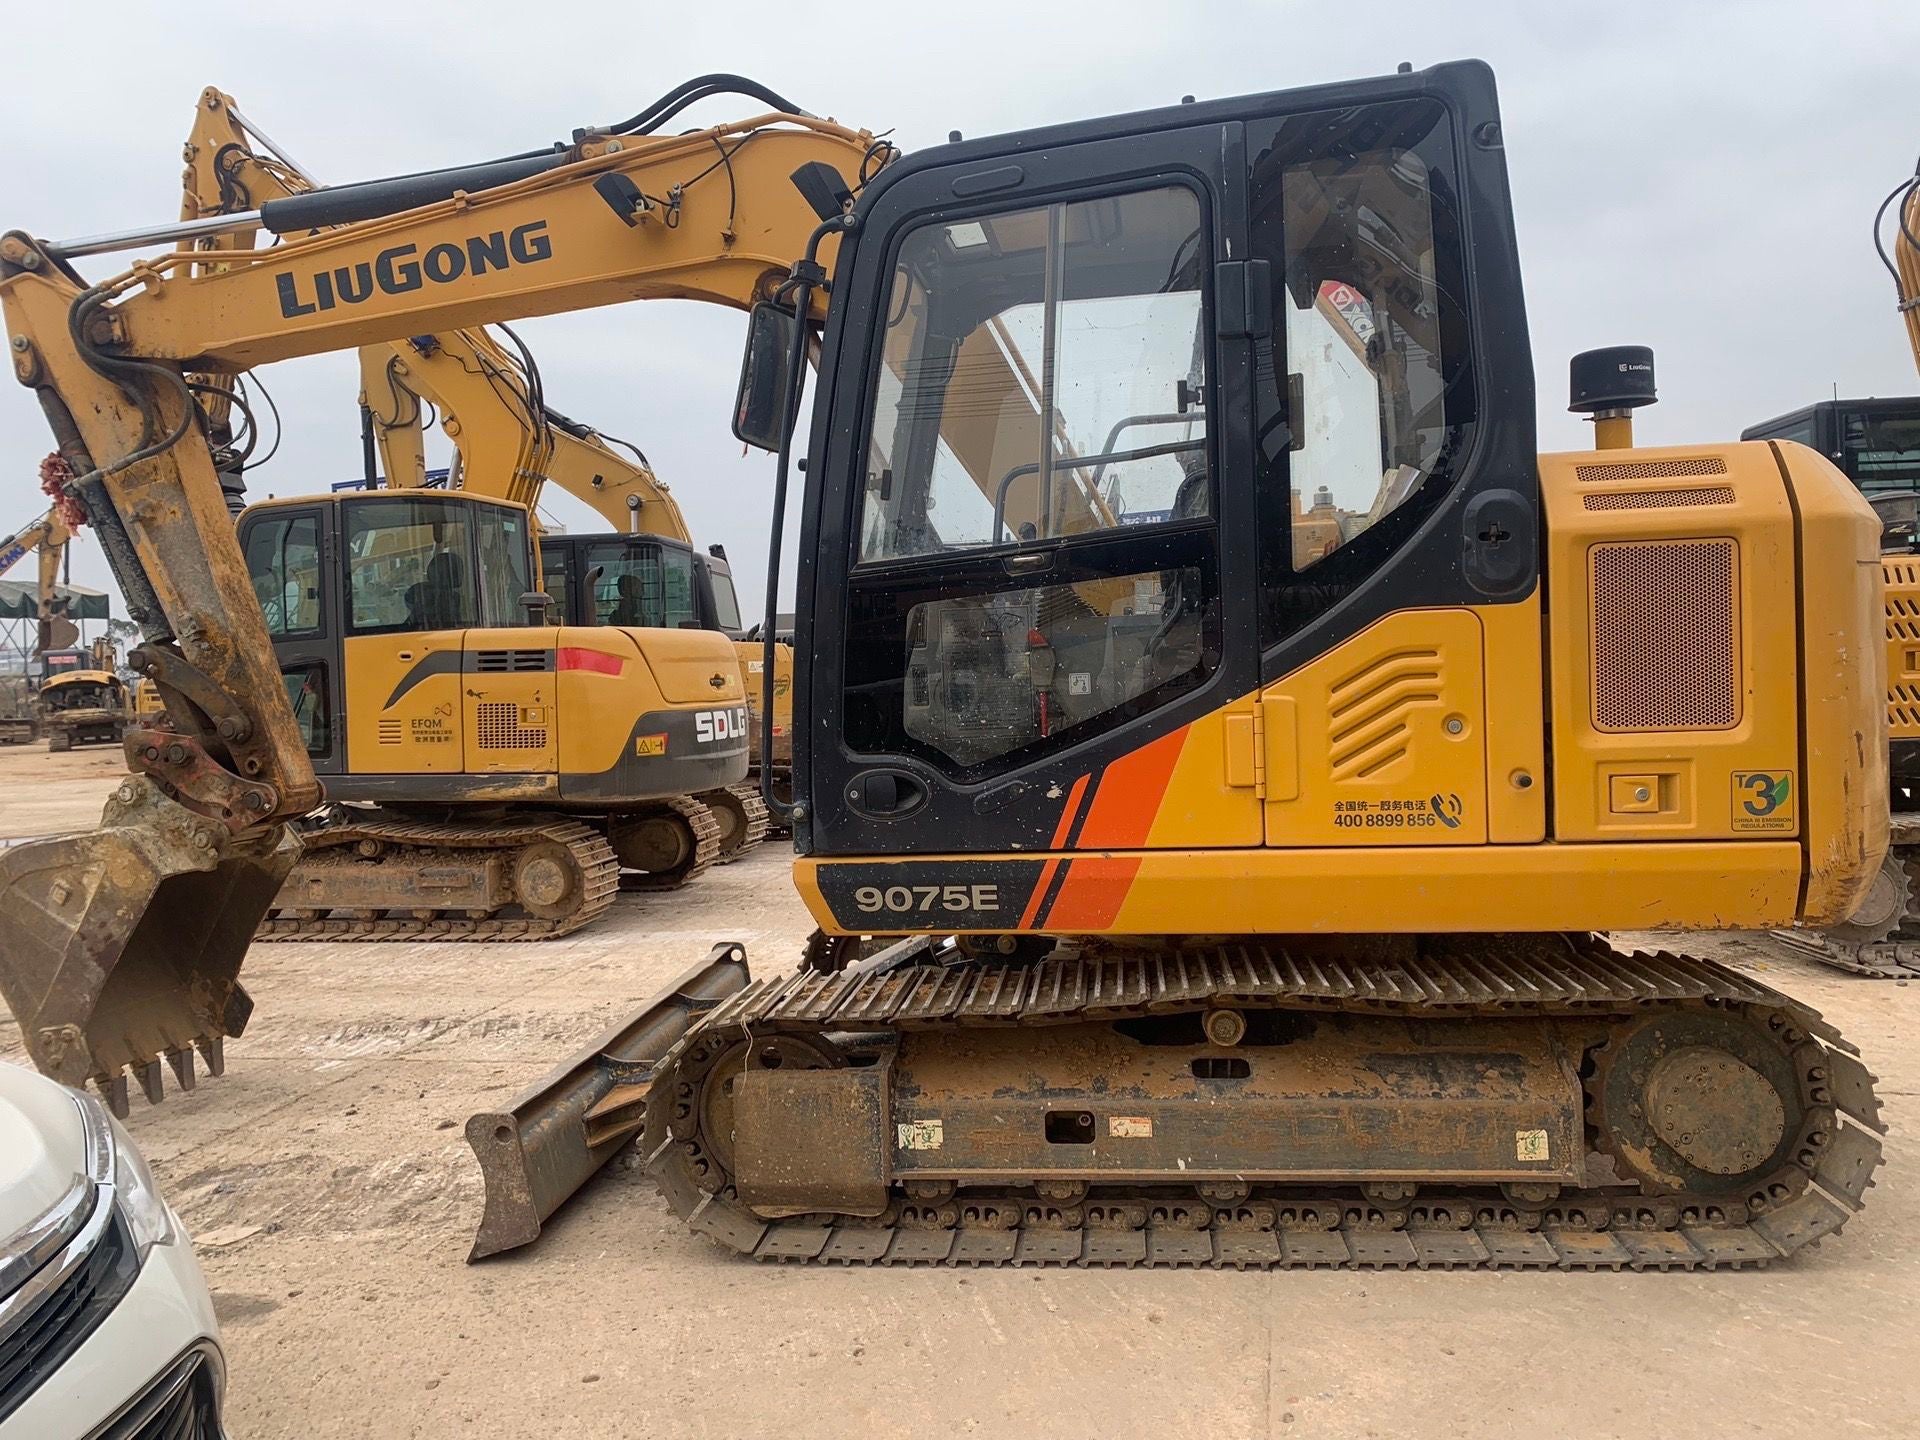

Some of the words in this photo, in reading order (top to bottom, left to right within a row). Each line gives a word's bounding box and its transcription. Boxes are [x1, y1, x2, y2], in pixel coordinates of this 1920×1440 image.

[275, 220, 552, 318] LIUGONG
[411, 719, 442, 729] EFQM
[695, 708, 746, 743] SDLG
[1334, 800, 1427, 812] 全国统一服务电话
[1334, 814, 1363, 828] 400
[1366, 814, 1404, 828] 8899
[1407, 813, 1436, 827] 856
[855, 885, 1000, 912] 9075E
